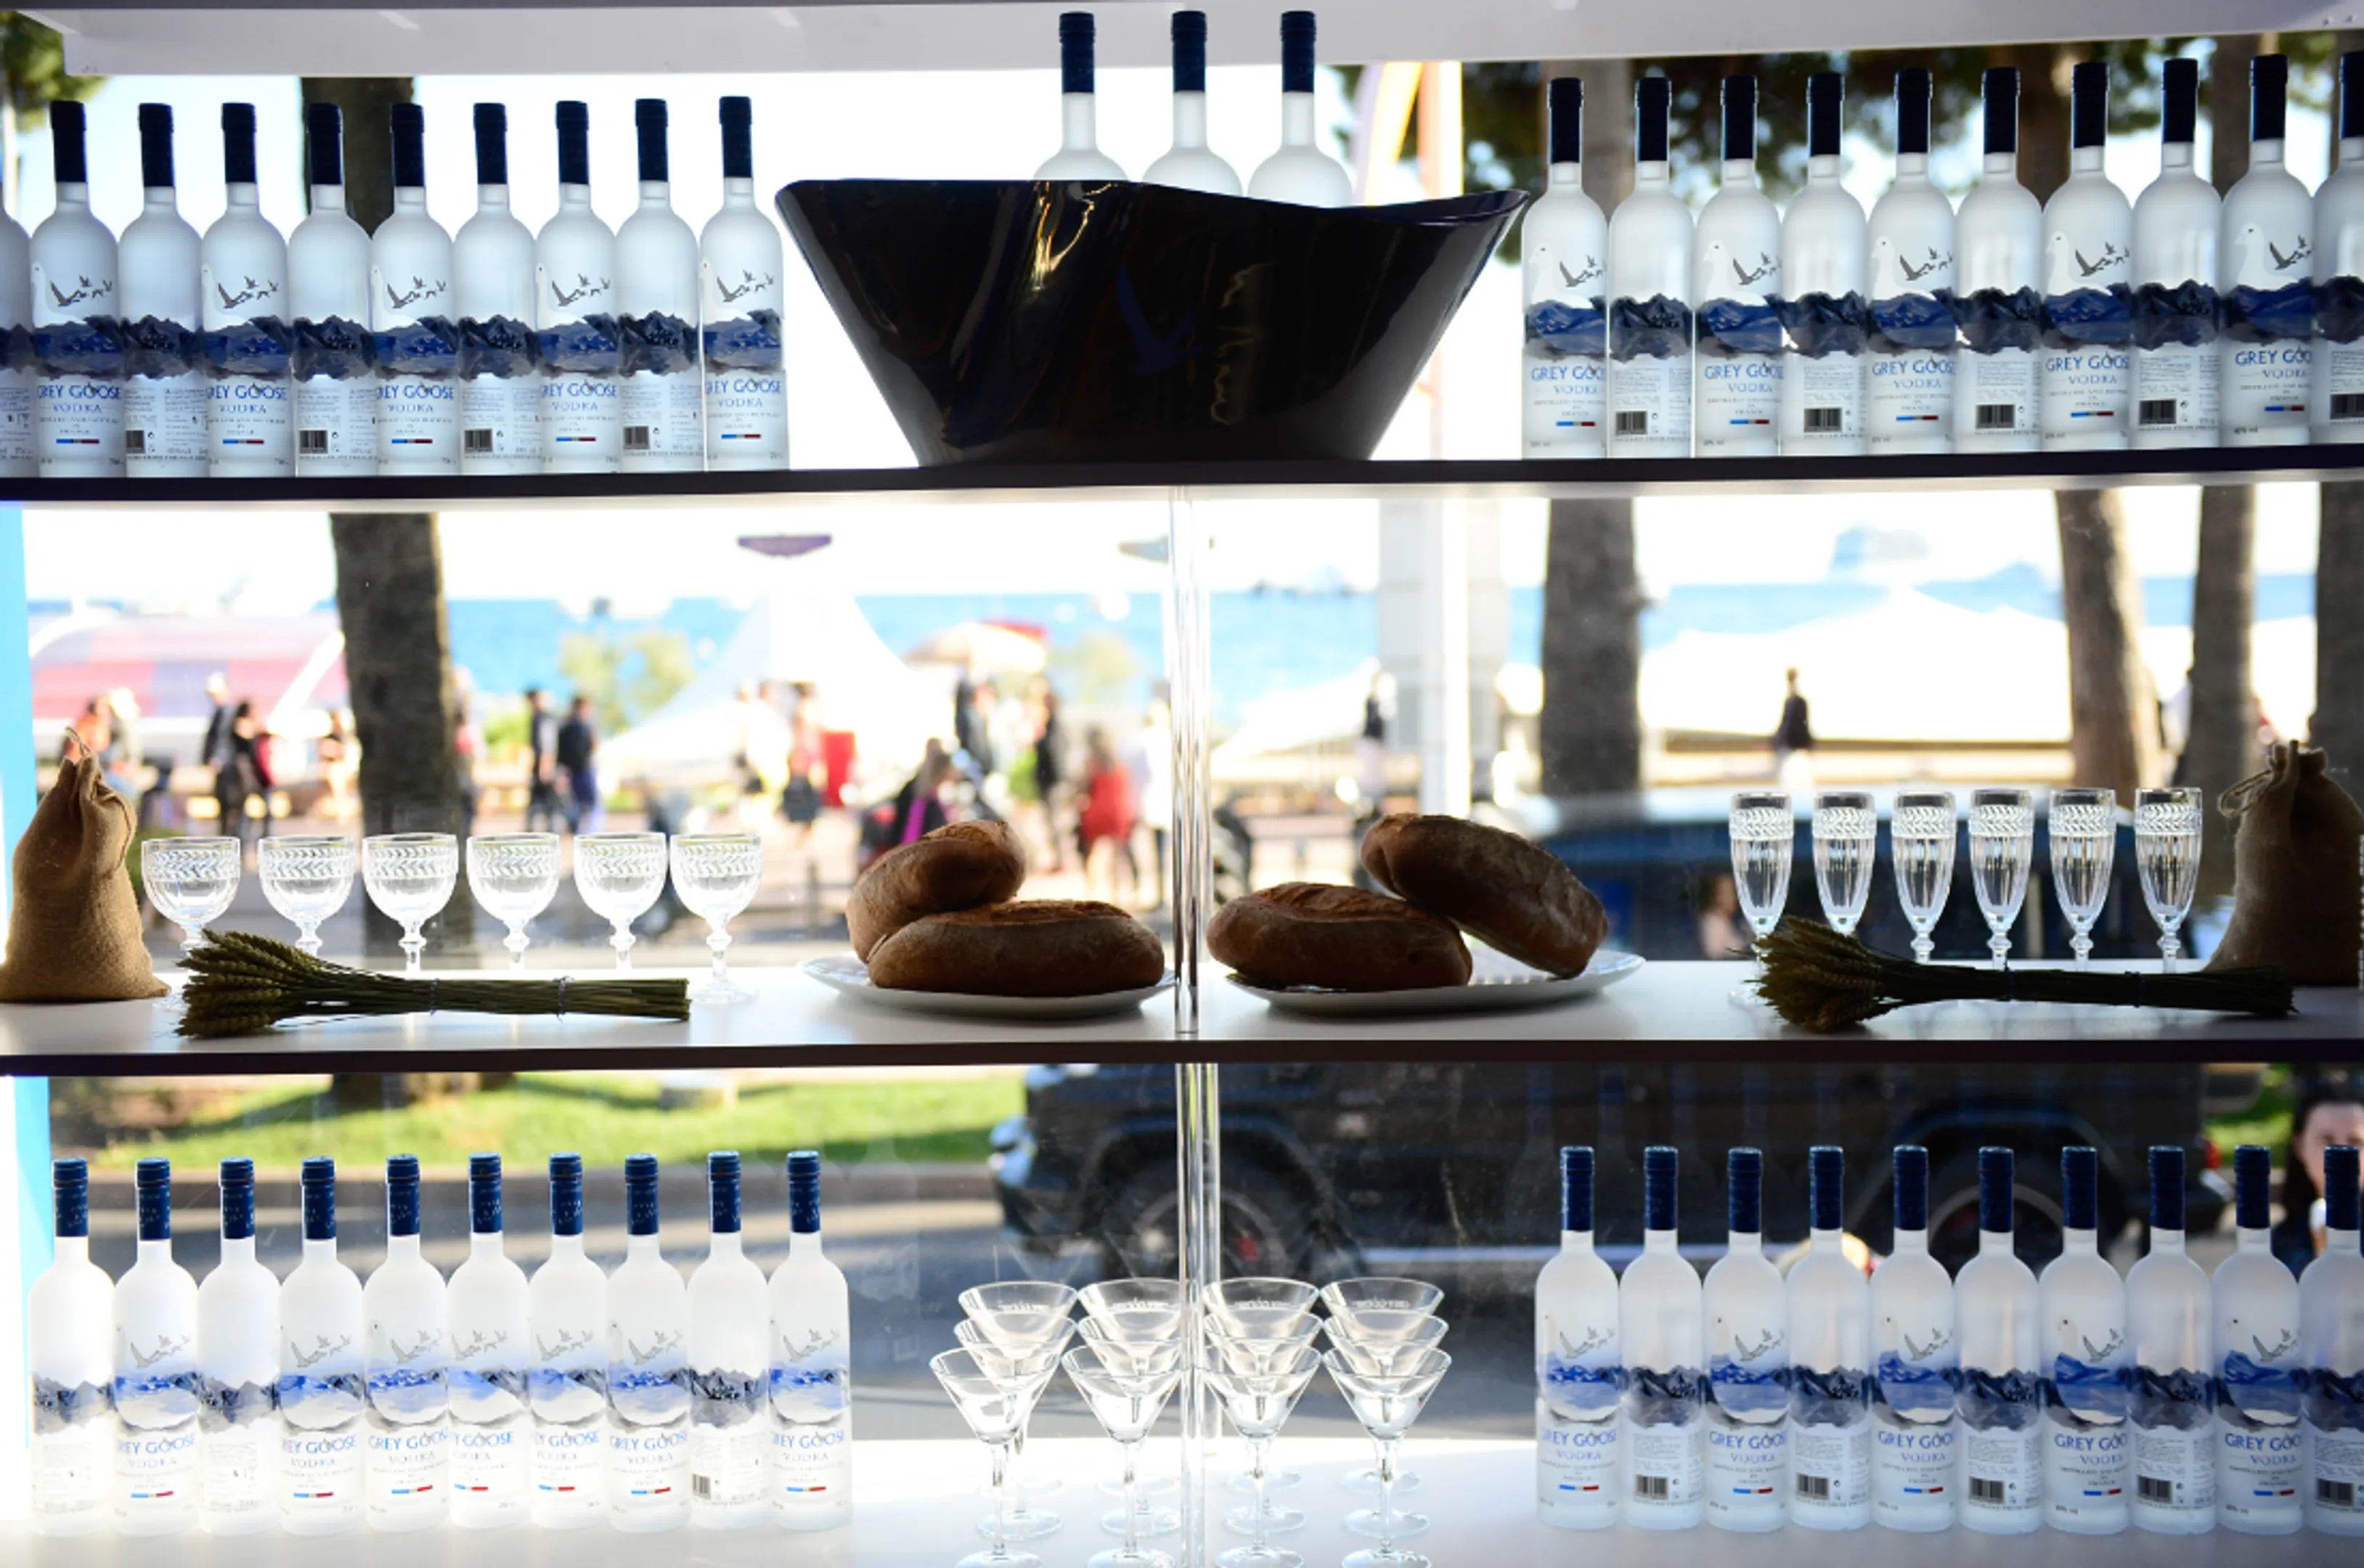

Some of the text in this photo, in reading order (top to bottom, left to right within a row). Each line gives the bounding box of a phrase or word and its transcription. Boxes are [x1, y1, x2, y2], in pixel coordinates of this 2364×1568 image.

[2045, 356, 2083, 372] GREY
[2234, 348, 2312, 367] GREY GOO
[1531, 365, 1607, 382] GREY GOO
[1705, 364, 1742, 380] GREY
[1871, 360, 1909, 377] GREY
[2068, 372, 2118, 385] VODKA
[2054, 1433, 2127, 1452] GREY GOO
[2224, 1433, 2302, 1452] GREY GOO
